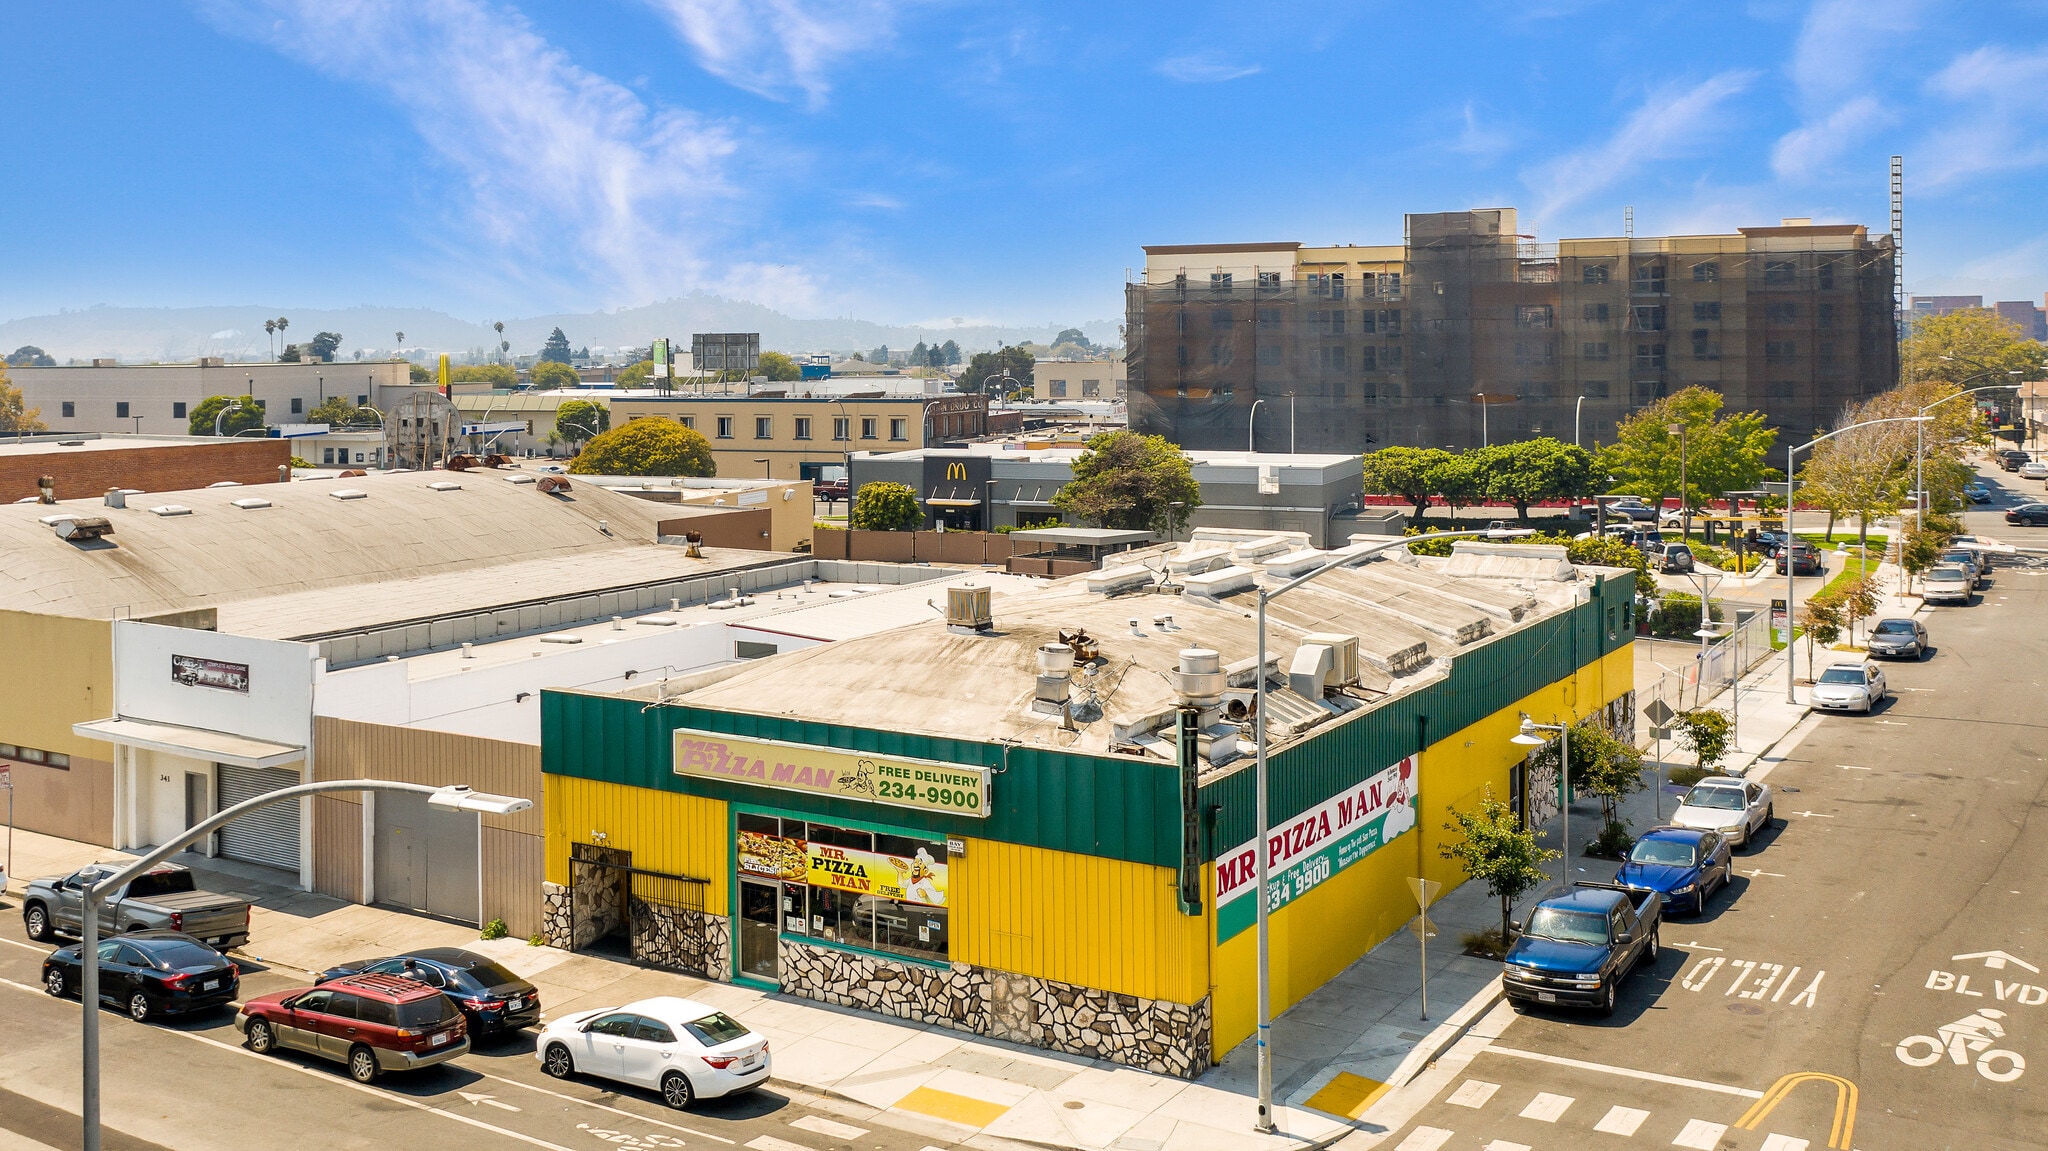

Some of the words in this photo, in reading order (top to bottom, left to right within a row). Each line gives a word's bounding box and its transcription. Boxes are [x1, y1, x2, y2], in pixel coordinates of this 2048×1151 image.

[770, 762, 835, 788] MAN
[878, 766, 911, 779] FREE
[915, 770, 978, 788] DELIVERY
[879, 780, 979, 809] 234-9900
[1268, 810, 1332, 870] PIZZA
[1338, 780, 1383, 830] MAN
[819, 846, 849, 861] MR.
[744, 863, 777, 875] SLICES!
[811, 856, 868, 878] PIZZA
[1296, 859, 1330, 896] 9900
[831, 874, 871, 891] MAN
[880, 884, 901, 893] FREE
[1267, 880, 1280, 894] ckup
[1288, 869, 1299, 881] Free
[877, 890, 904, 898] DELIVERY
[1681, 956, 1825, 1008] YIELD
